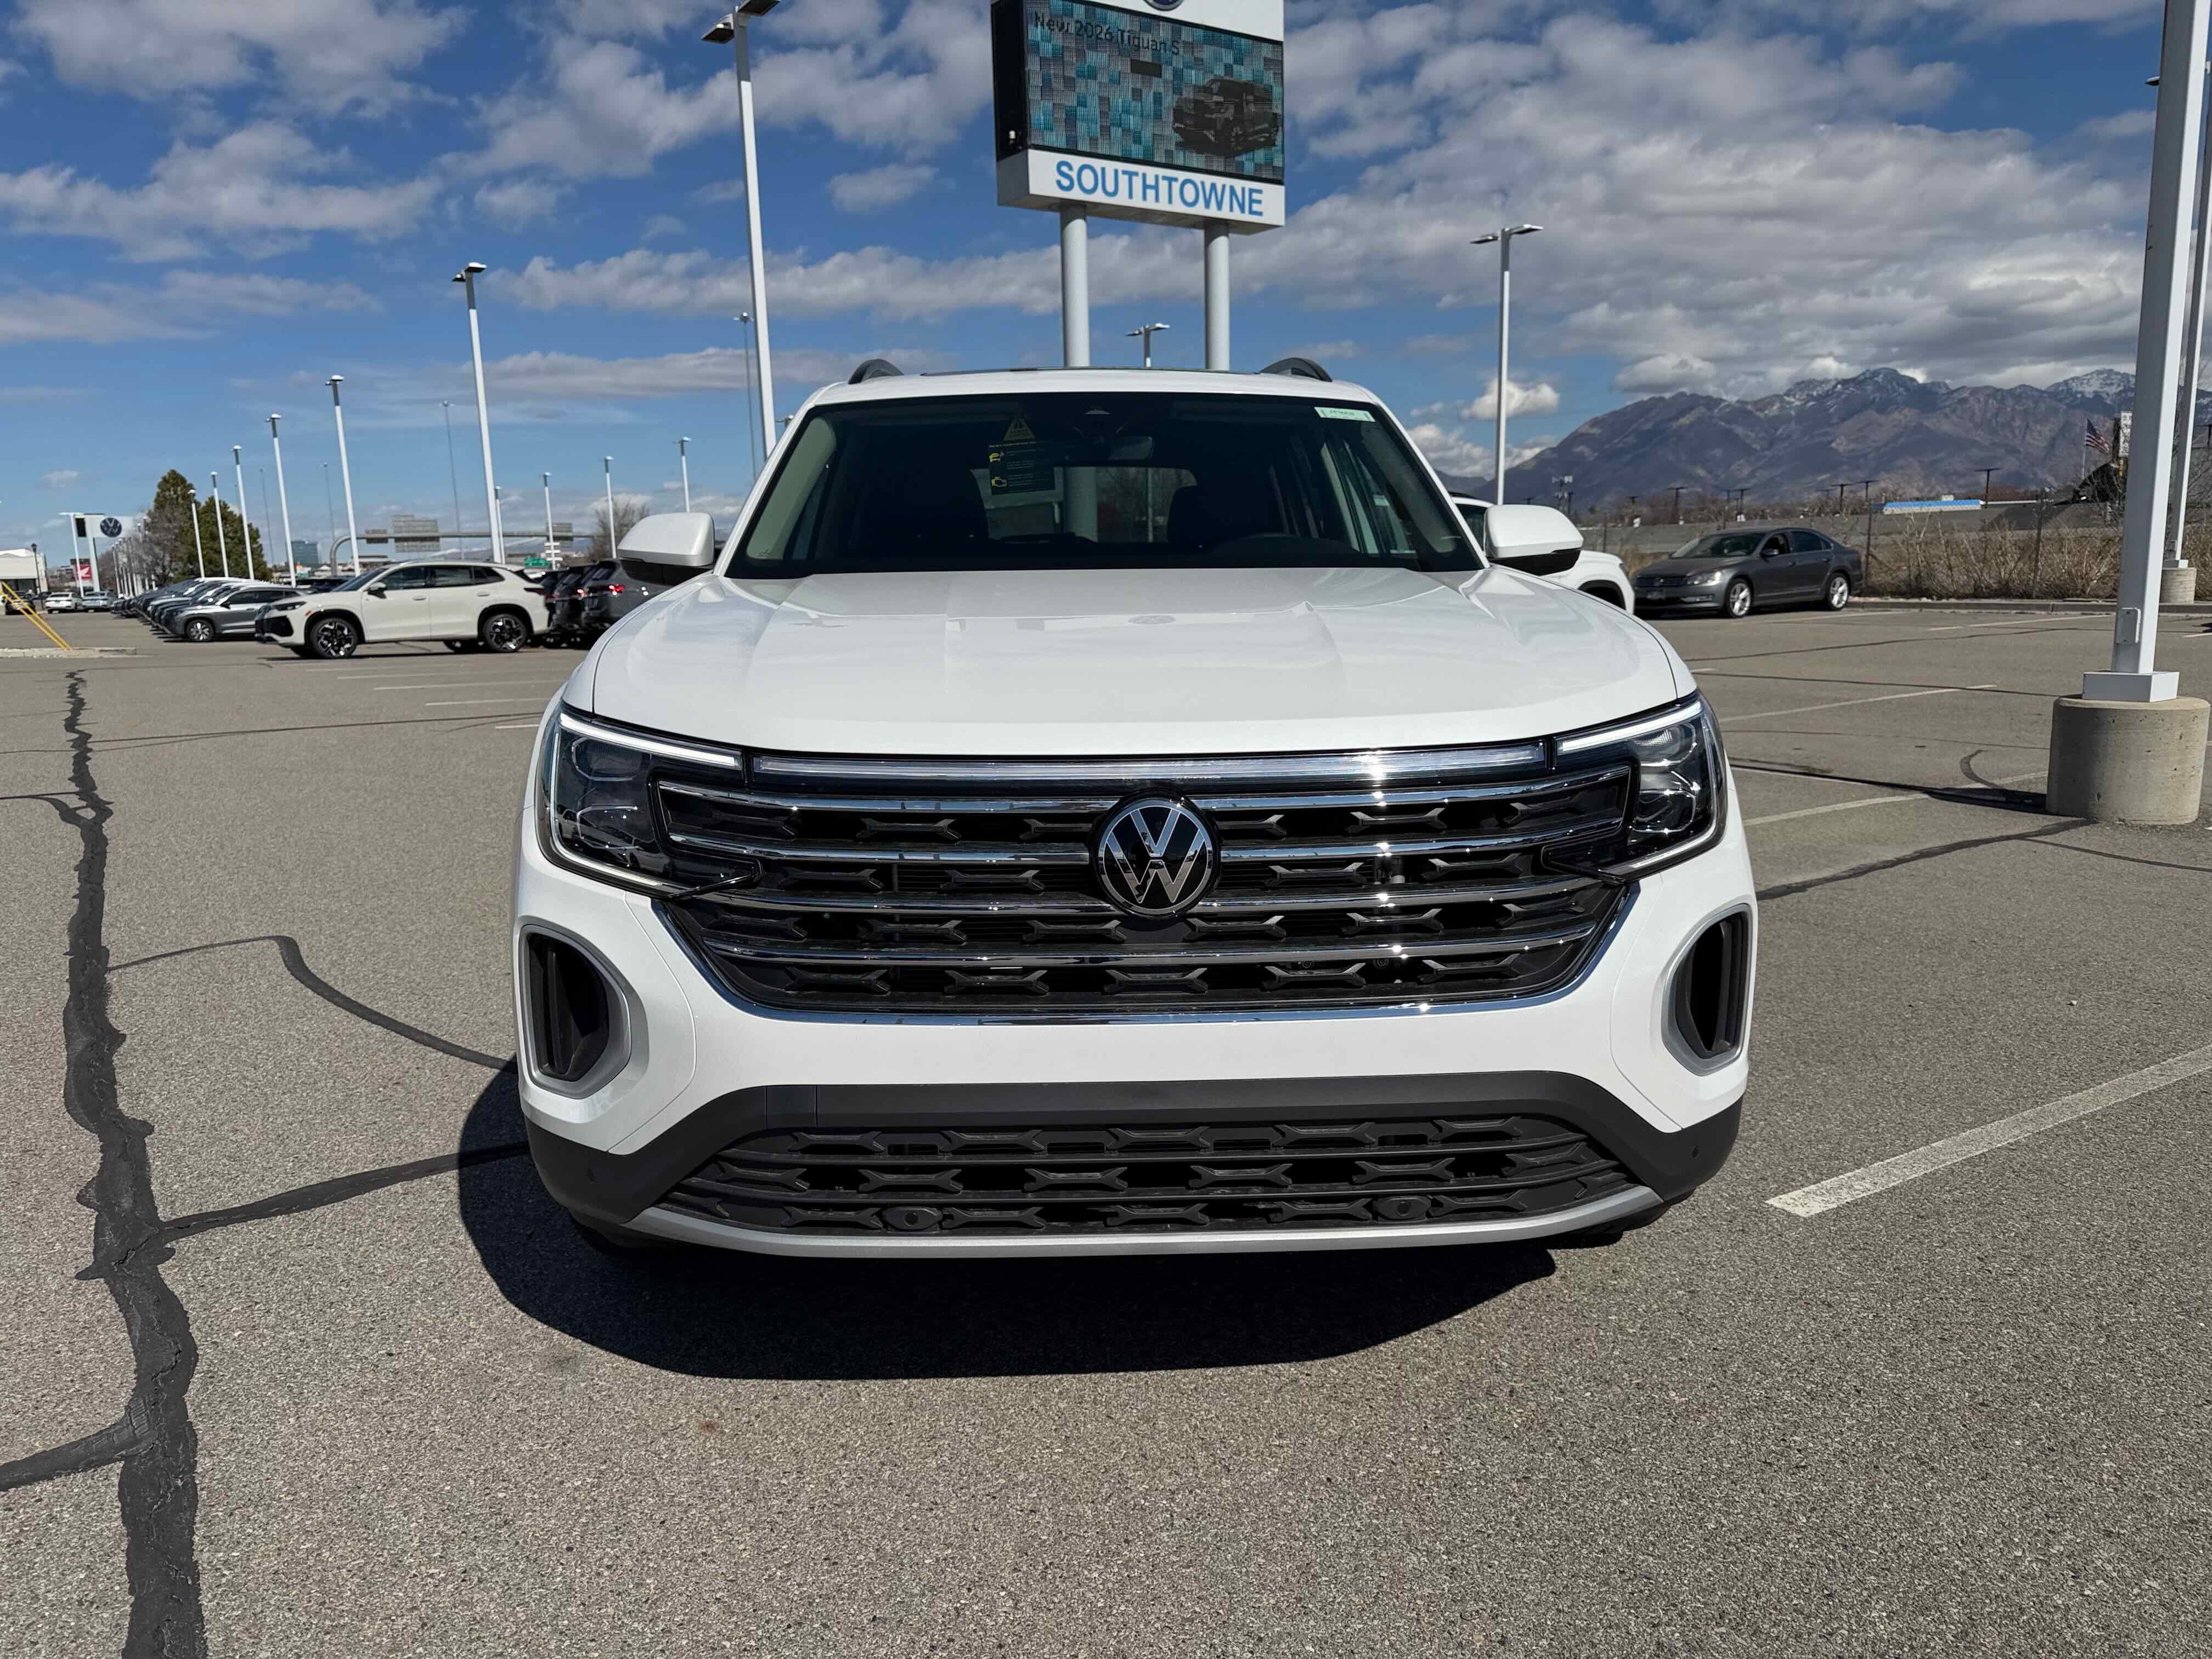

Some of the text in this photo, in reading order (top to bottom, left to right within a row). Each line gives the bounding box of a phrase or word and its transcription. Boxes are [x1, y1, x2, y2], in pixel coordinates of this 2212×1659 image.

[1035, 10, 1180, 55] New 2026 Tiguan S
[1056, 160, 1264, 217] SOUTHTOWNE
[1104, 806, 1207, 905] VW
